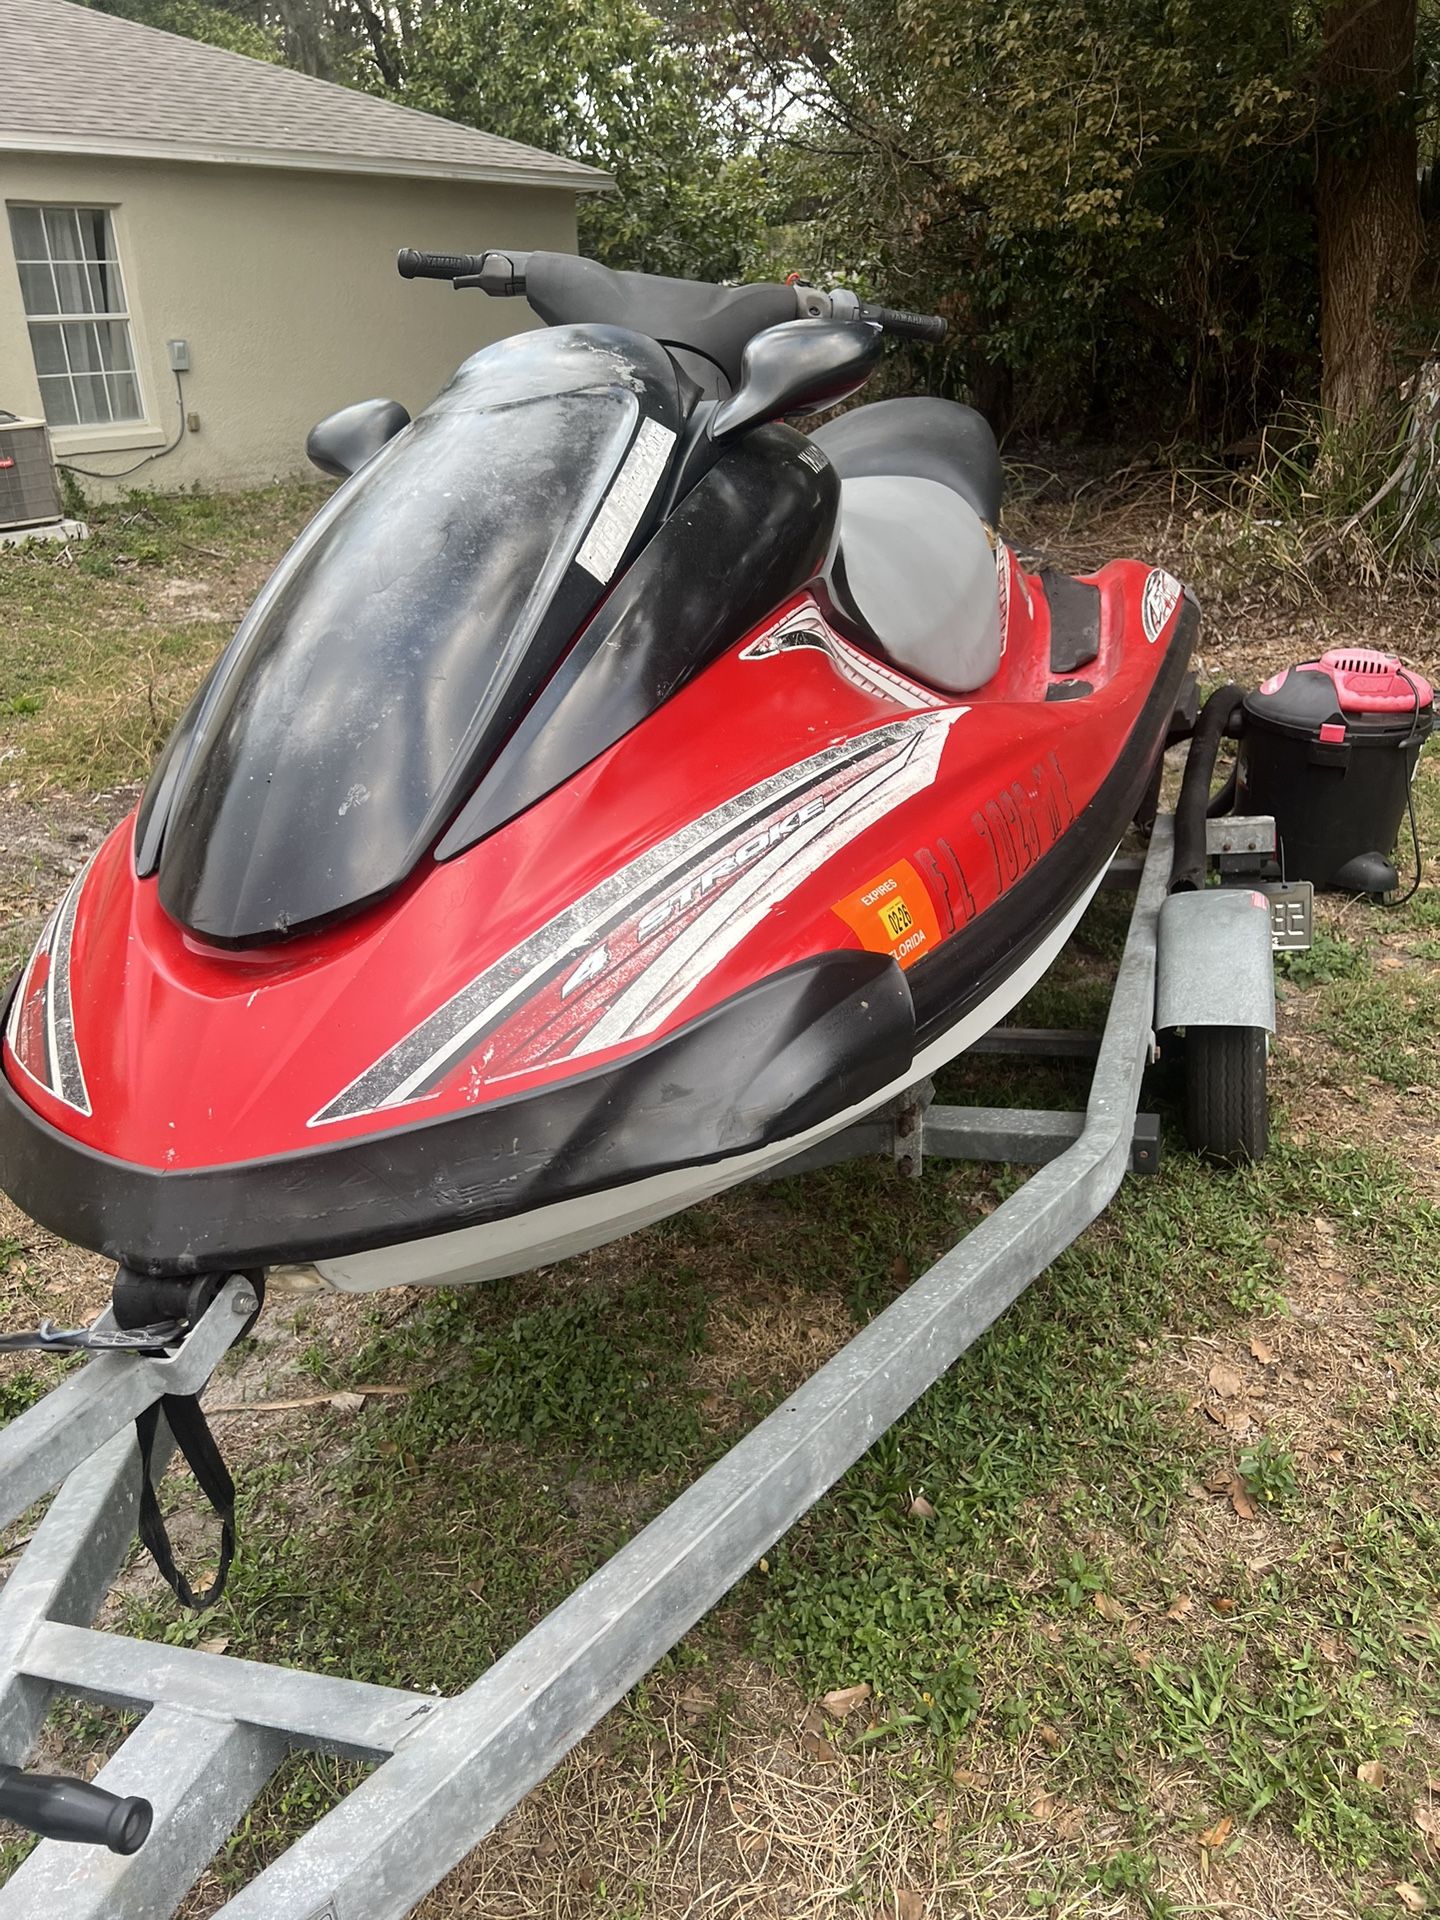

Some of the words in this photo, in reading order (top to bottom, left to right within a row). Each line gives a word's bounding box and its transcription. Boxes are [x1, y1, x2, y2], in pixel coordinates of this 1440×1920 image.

[561, 940, 612, 1000] 4
[636, 794, 826, 944] STROKE
[860, 878, 898, 907] EXPIRES
